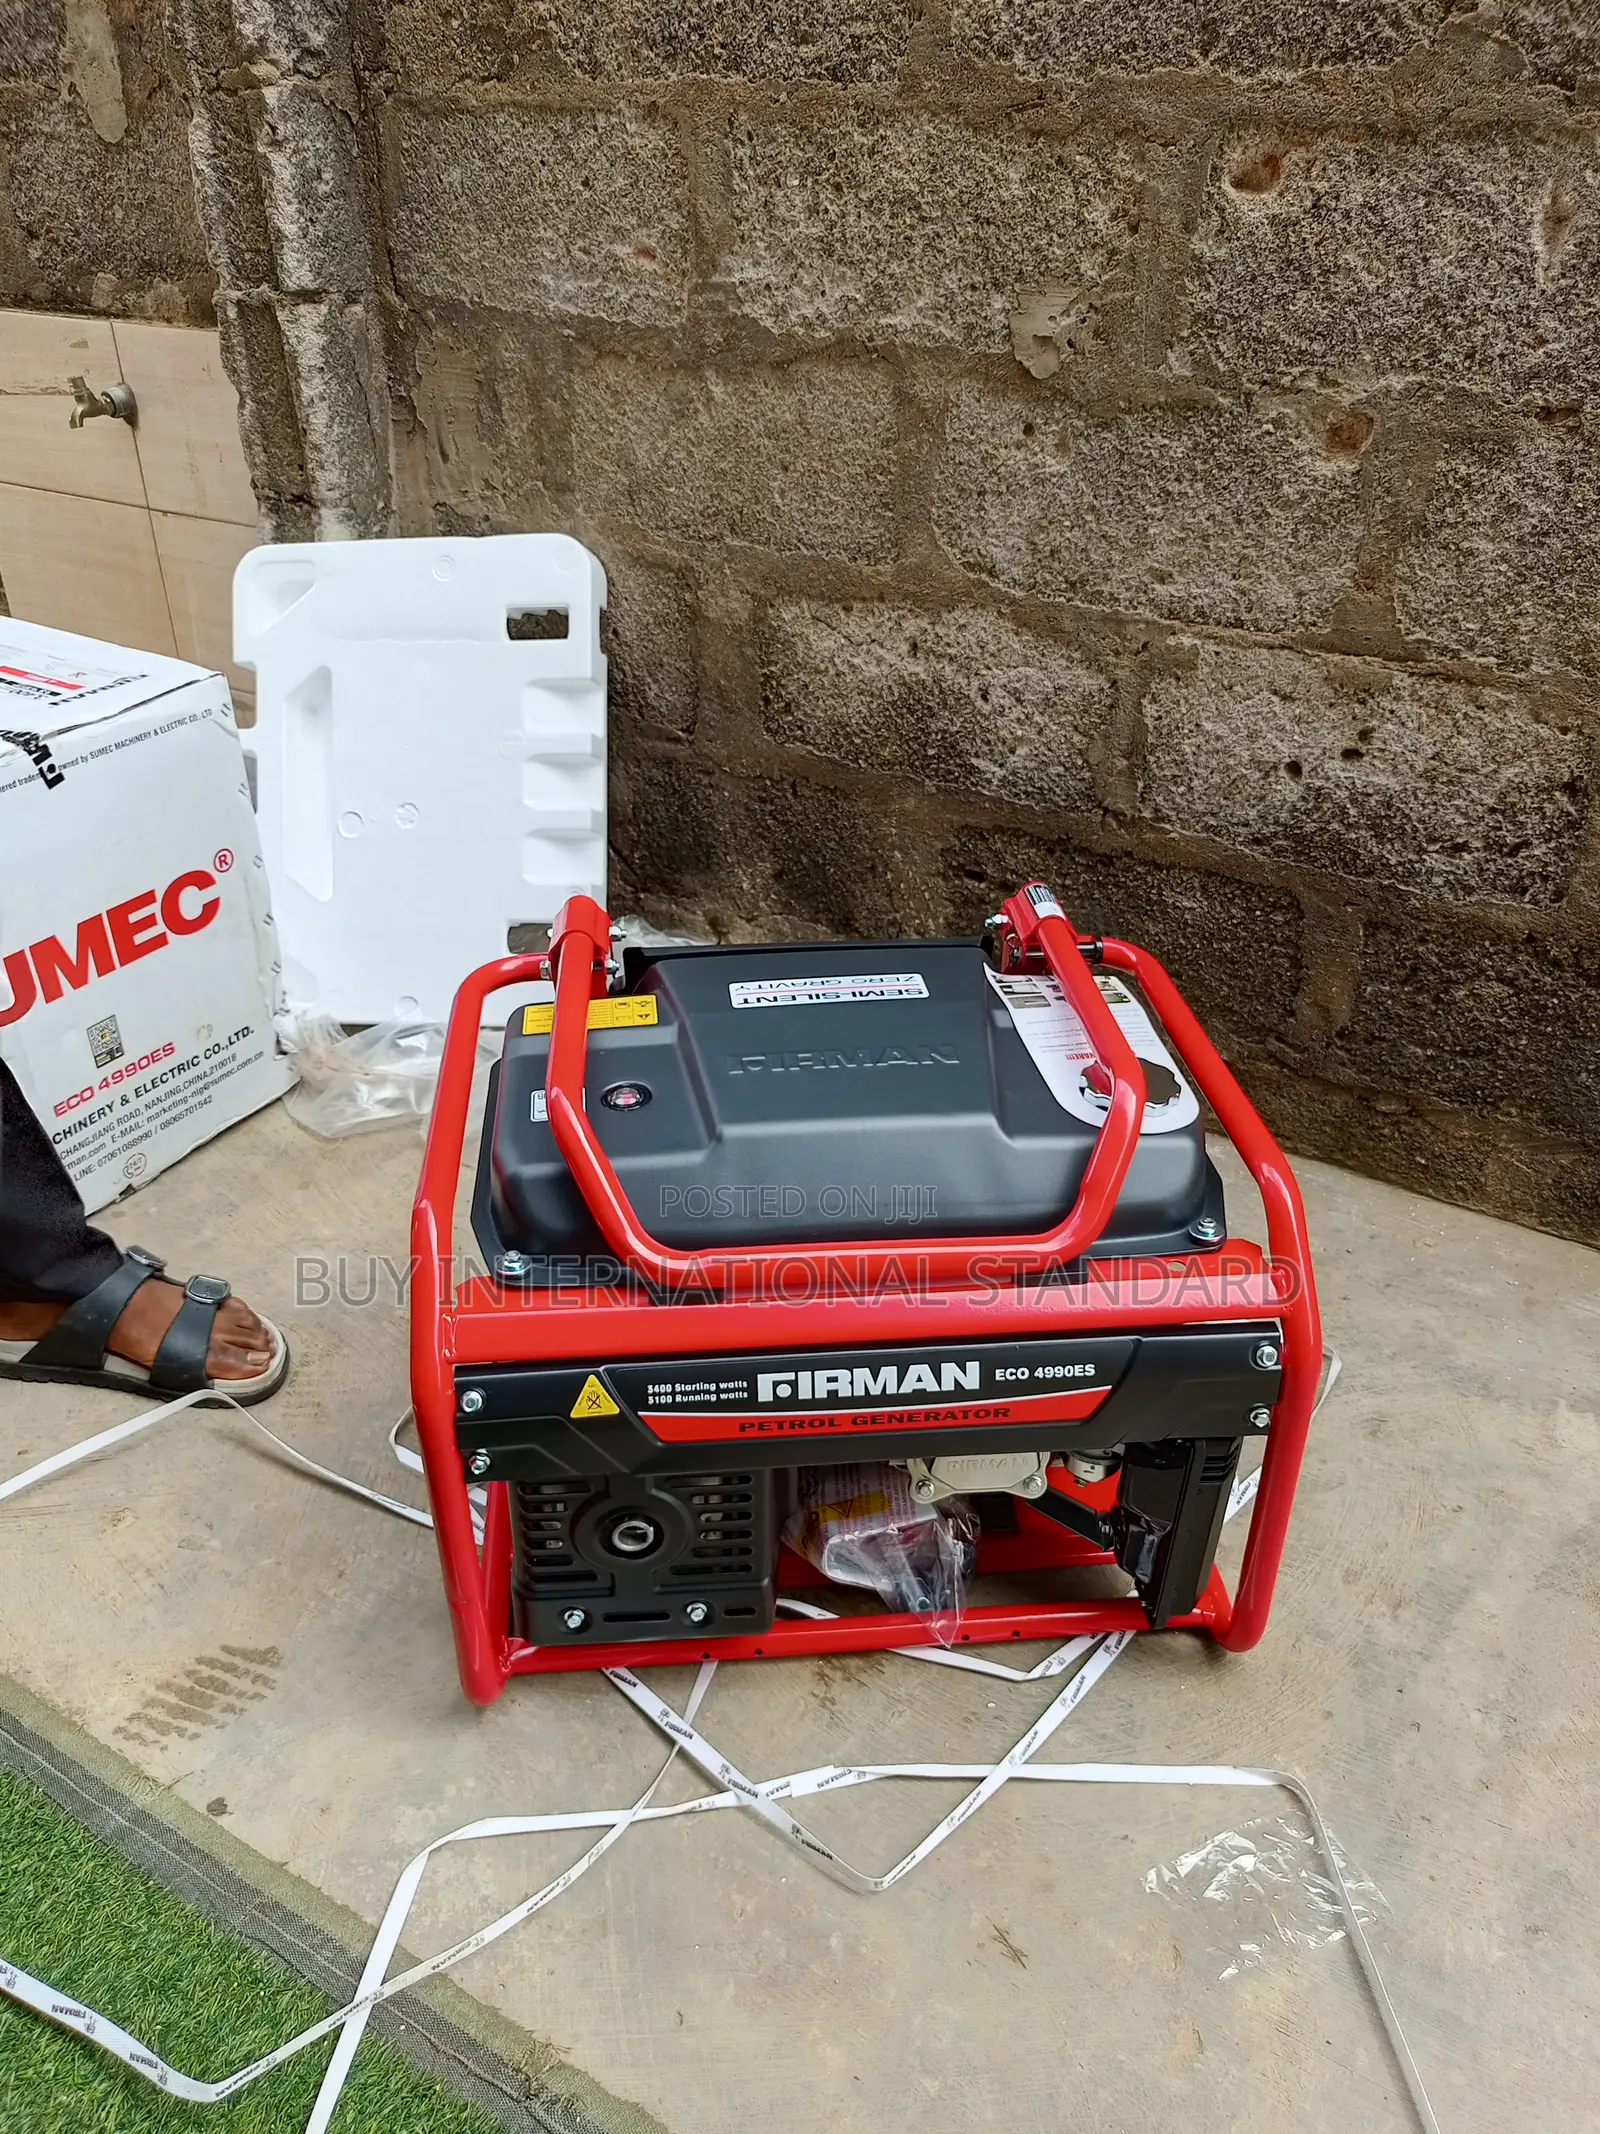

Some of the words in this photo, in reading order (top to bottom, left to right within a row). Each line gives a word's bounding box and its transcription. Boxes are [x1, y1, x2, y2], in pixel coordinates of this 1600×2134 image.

[58, 757, 80, 771] owned
[80, 754, 89, 764] by
[89, 745, 114, 760] SUMEC
[114, 730, 152, 750] MACHINERY
[153, 728, 160, 737] &
[159, 717, 189, 734] ELECTRIC
[735, 978, 842, 992] GRAVITY
[851, 975, 918, 984] ZERO
[736, 987, 924, 1006] SEMI-SILENT
[727, 1045, 960, 1075] FIRMAN
[53, 1086, 96, 1118] ECO
[98, 1041, 176, 1091] 4990ES
[119, 1094, 132, 1107] &
[134, 1055, 201, 1099] ELECTRIC
[111, 1120, 146, 1144] E-MAIL:
[60, 1123, 116, 1161] CHANGJIANG
[756, 1360, 981, 1403] FIRMAN
[995, 1367, 1030, 1381] ECO
[1034, 1363, 1096, 1379] 4990ES
[646, 1383, 673, 1394] 3400
[674, 1381, 717, 1392] Starting
[718, 1380, 748, 1389] watts
[647, 1395, 673, 1405] 3100
[675, 1392, 717, 1403] Running
[719, 1391, 748, 1400] watts
[738, 1418, 842, 1433] PETROL
[850, 1407, 1012, 1426] GENERATOR
[609, 1670, 639, 1688] FIRMAN
[665, 1721, 694, 1740] FIRMAN
[727, 1778, 759, 1799] FIRMAN
[51, 2003, 87, 2020] FIRMAN
[129, 2052, 159, 2070] FIRMAN
